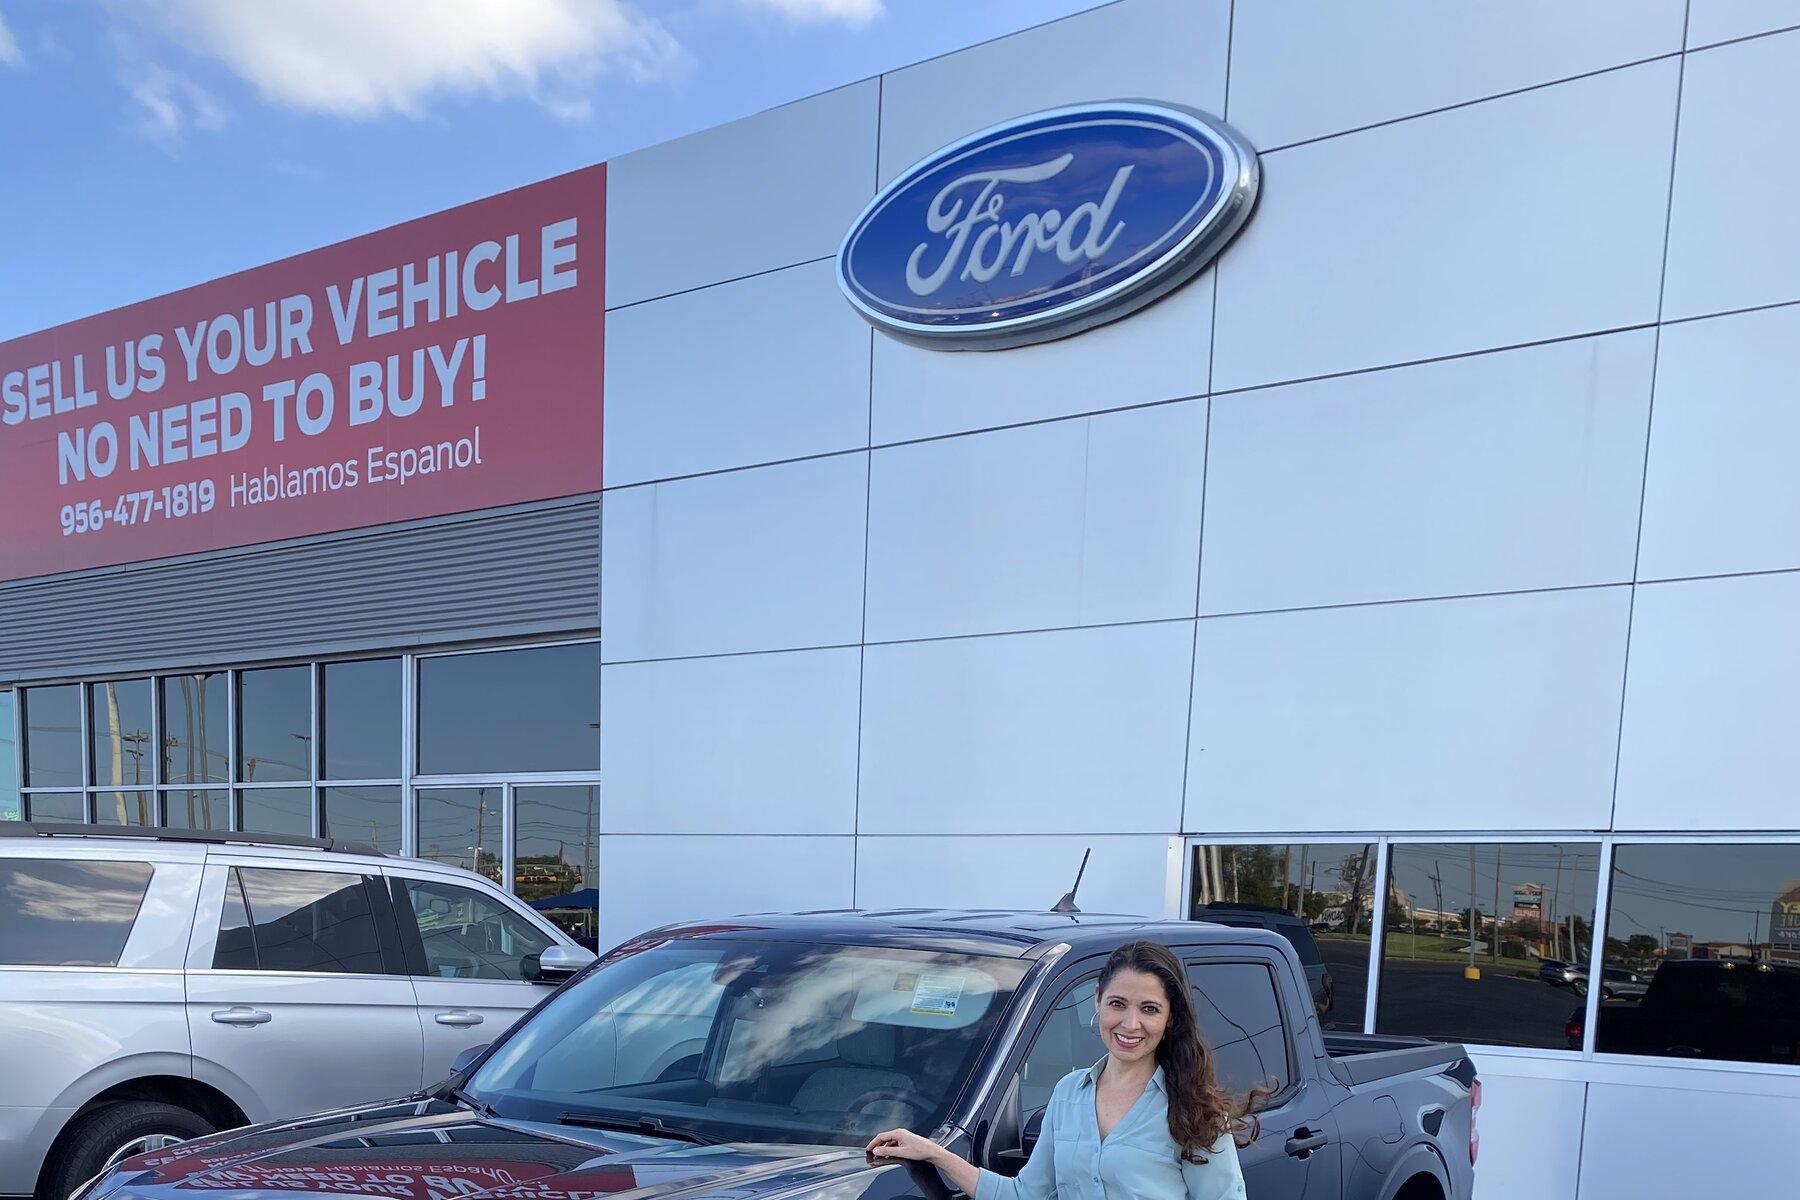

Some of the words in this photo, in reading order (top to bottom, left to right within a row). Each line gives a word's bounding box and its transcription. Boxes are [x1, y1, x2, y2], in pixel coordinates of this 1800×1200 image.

[906, 153, 1135, 296] Ford
[1, 353, 99, 425] SELL
[106, 334, 166, 402] US
[175, 293, 314, 383] YOUR
[326, 217, 578, 346] VEHICLE
[57, 420, 119, 486] NO
[129, 391, 252, 471] NEED
[262, 372, 335, 442] TO
[349, 334, 486, 427] BUY!
[60, 479, 216, 537] 956-477-1819
[230, 458, 359, 508] Hablamos
[367, 427, 482, 485] Espanol
